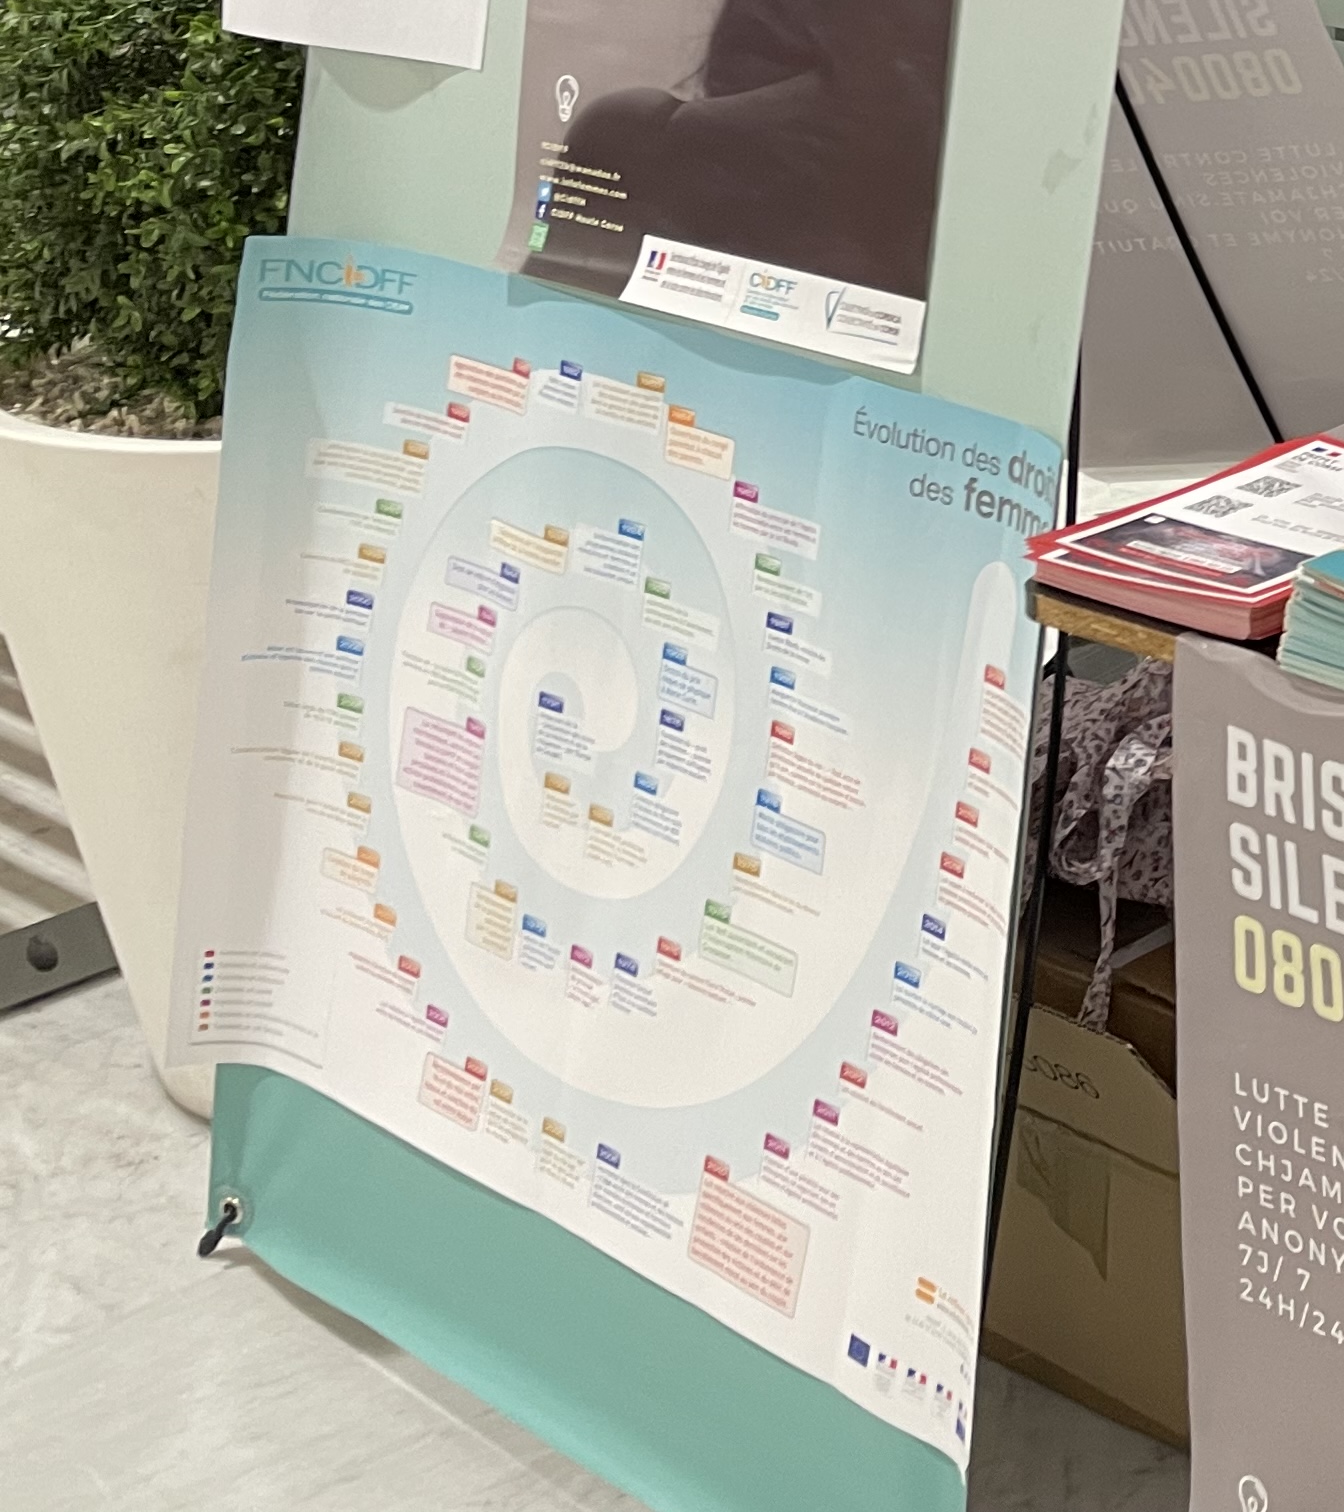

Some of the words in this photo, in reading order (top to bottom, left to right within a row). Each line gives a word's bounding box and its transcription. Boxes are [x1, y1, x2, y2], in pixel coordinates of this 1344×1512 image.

[852, 404, 956, 462] Évolution
[960, 442, 1002, 477] des
[909, 473, 955, 507] des
[1233, 1070, 1333, 1131] LUTTE
[1236, 1174, 1299, 1216] PER
[1237, 1242, 1285, 1283] 7J/
[1295, 1266, 1313, 1292] 7
